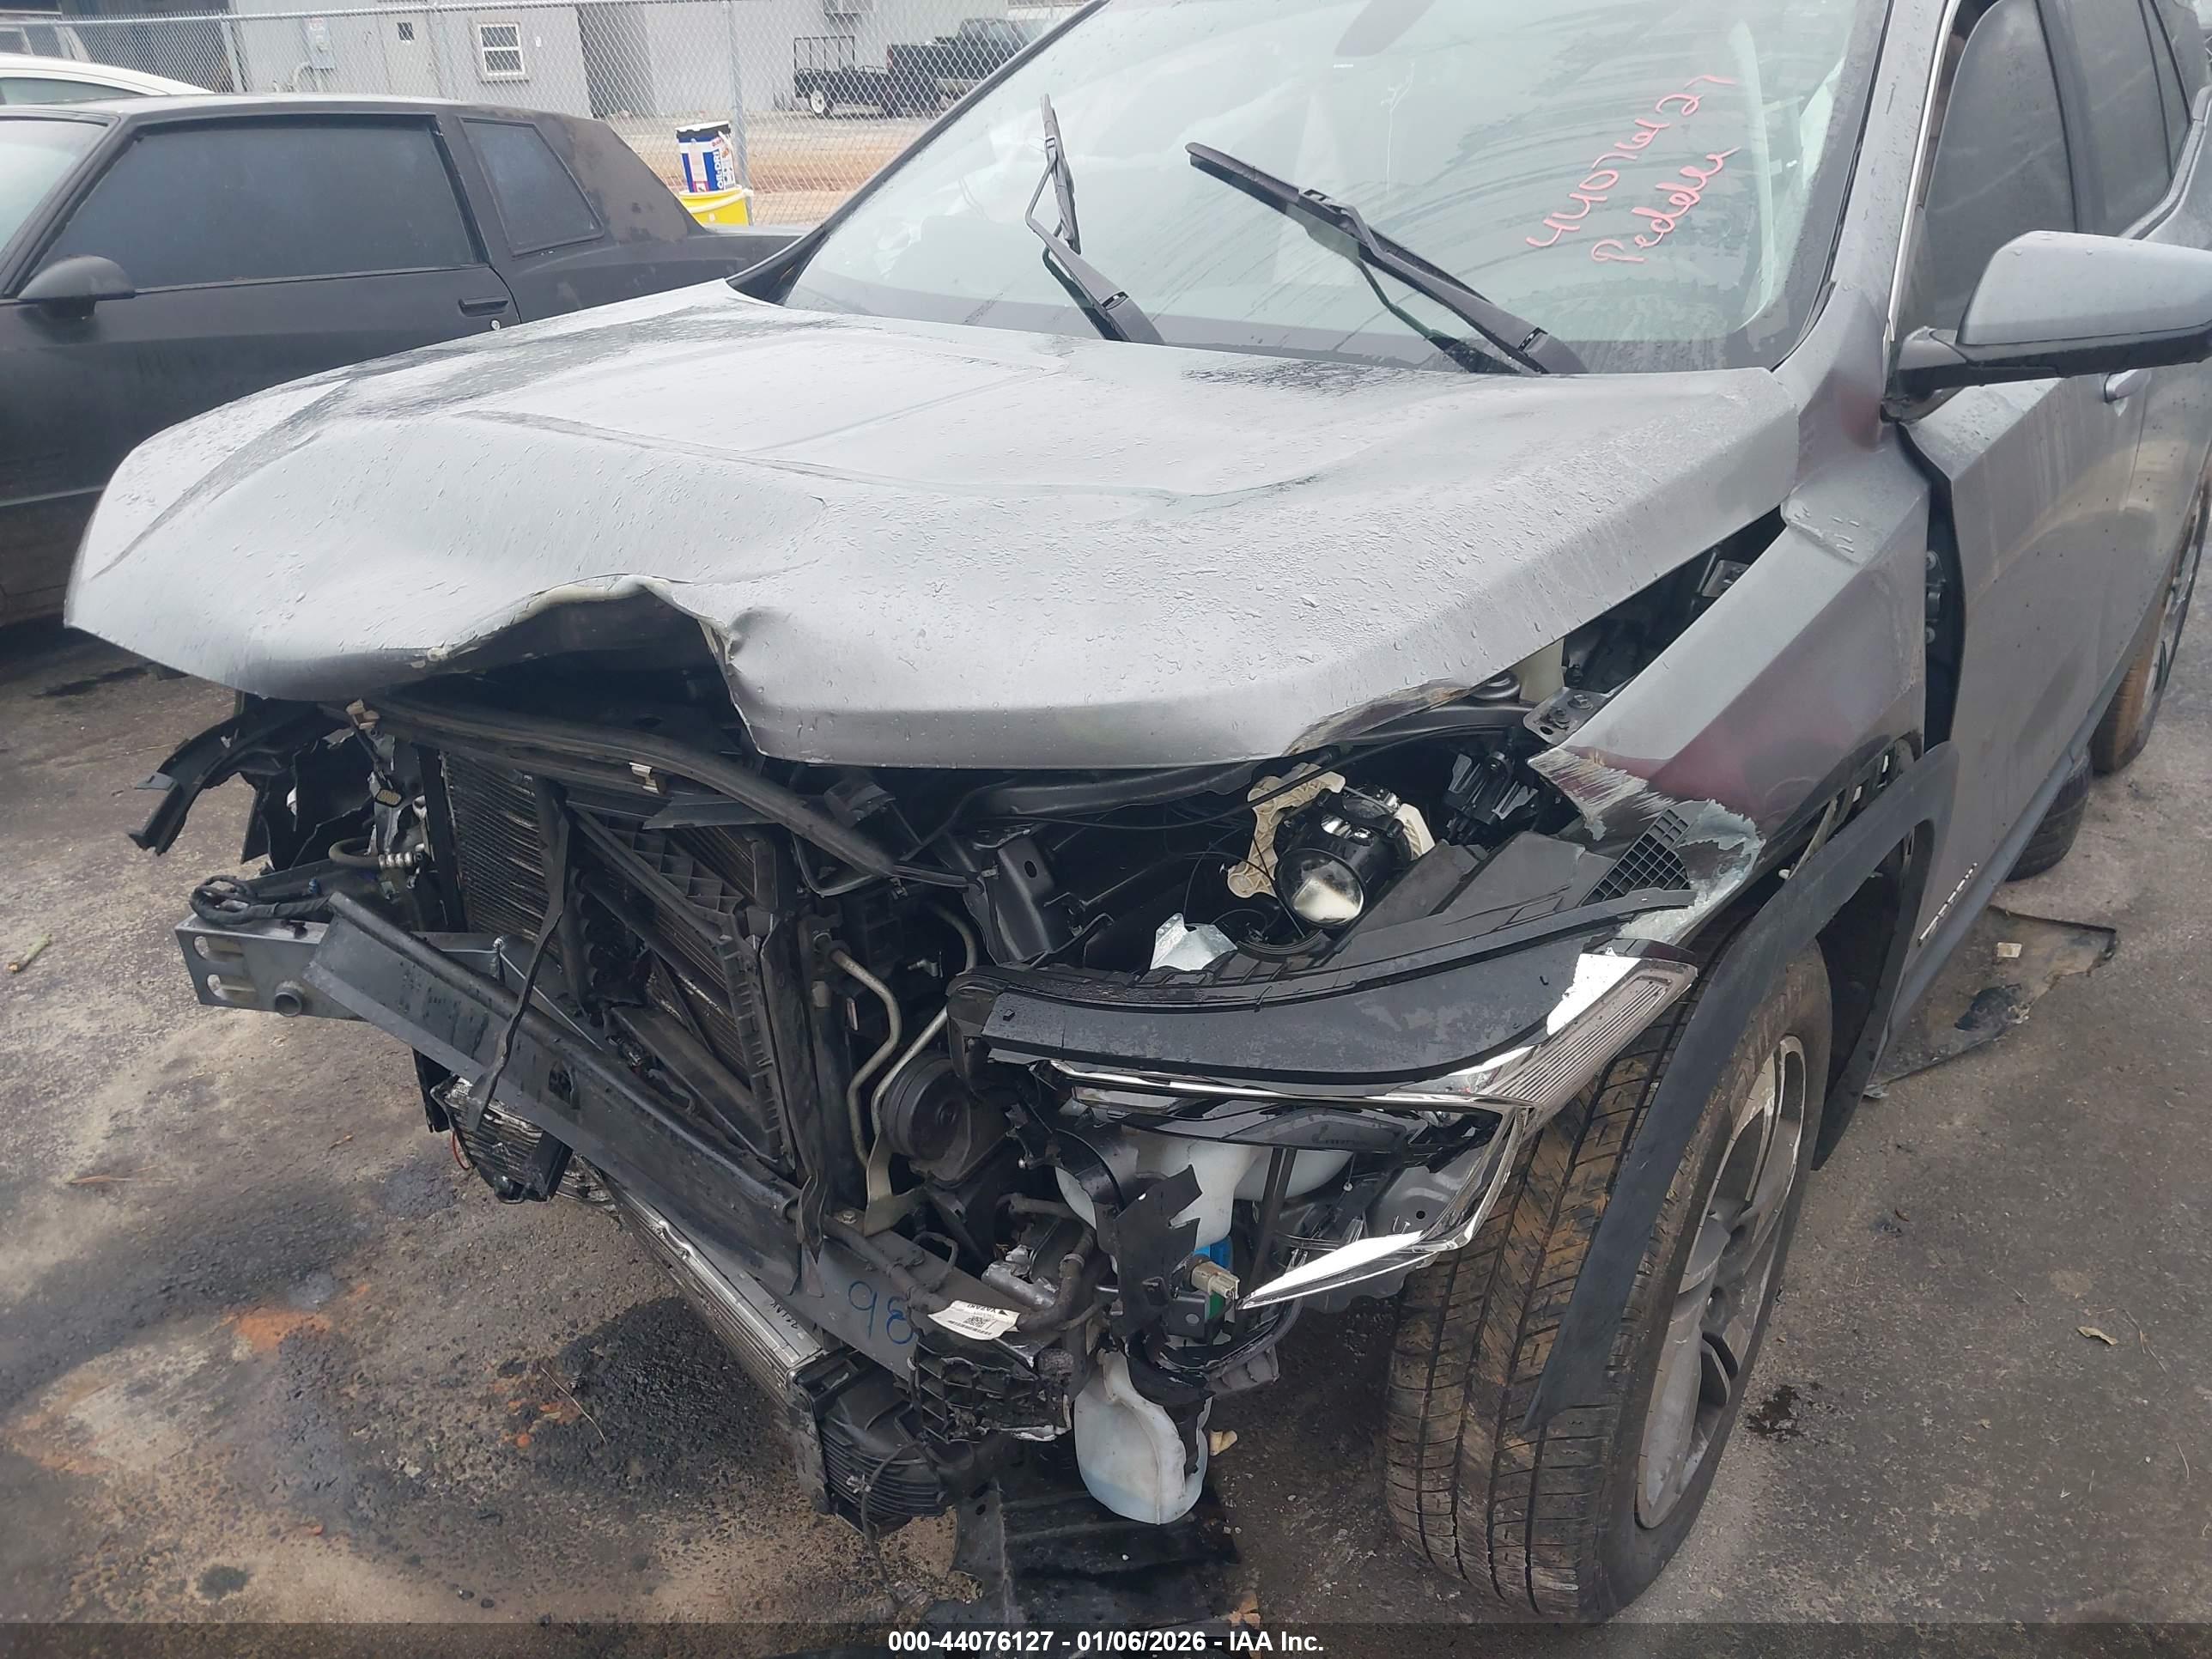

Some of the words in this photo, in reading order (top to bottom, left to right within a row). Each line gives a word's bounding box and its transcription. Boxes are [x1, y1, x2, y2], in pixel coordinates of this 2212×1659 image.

[713, 150, 724, 190] OIL-DRI
[1526, 74, 1737, 247] 44076127
[848, 1280, 916, 1345] 98
